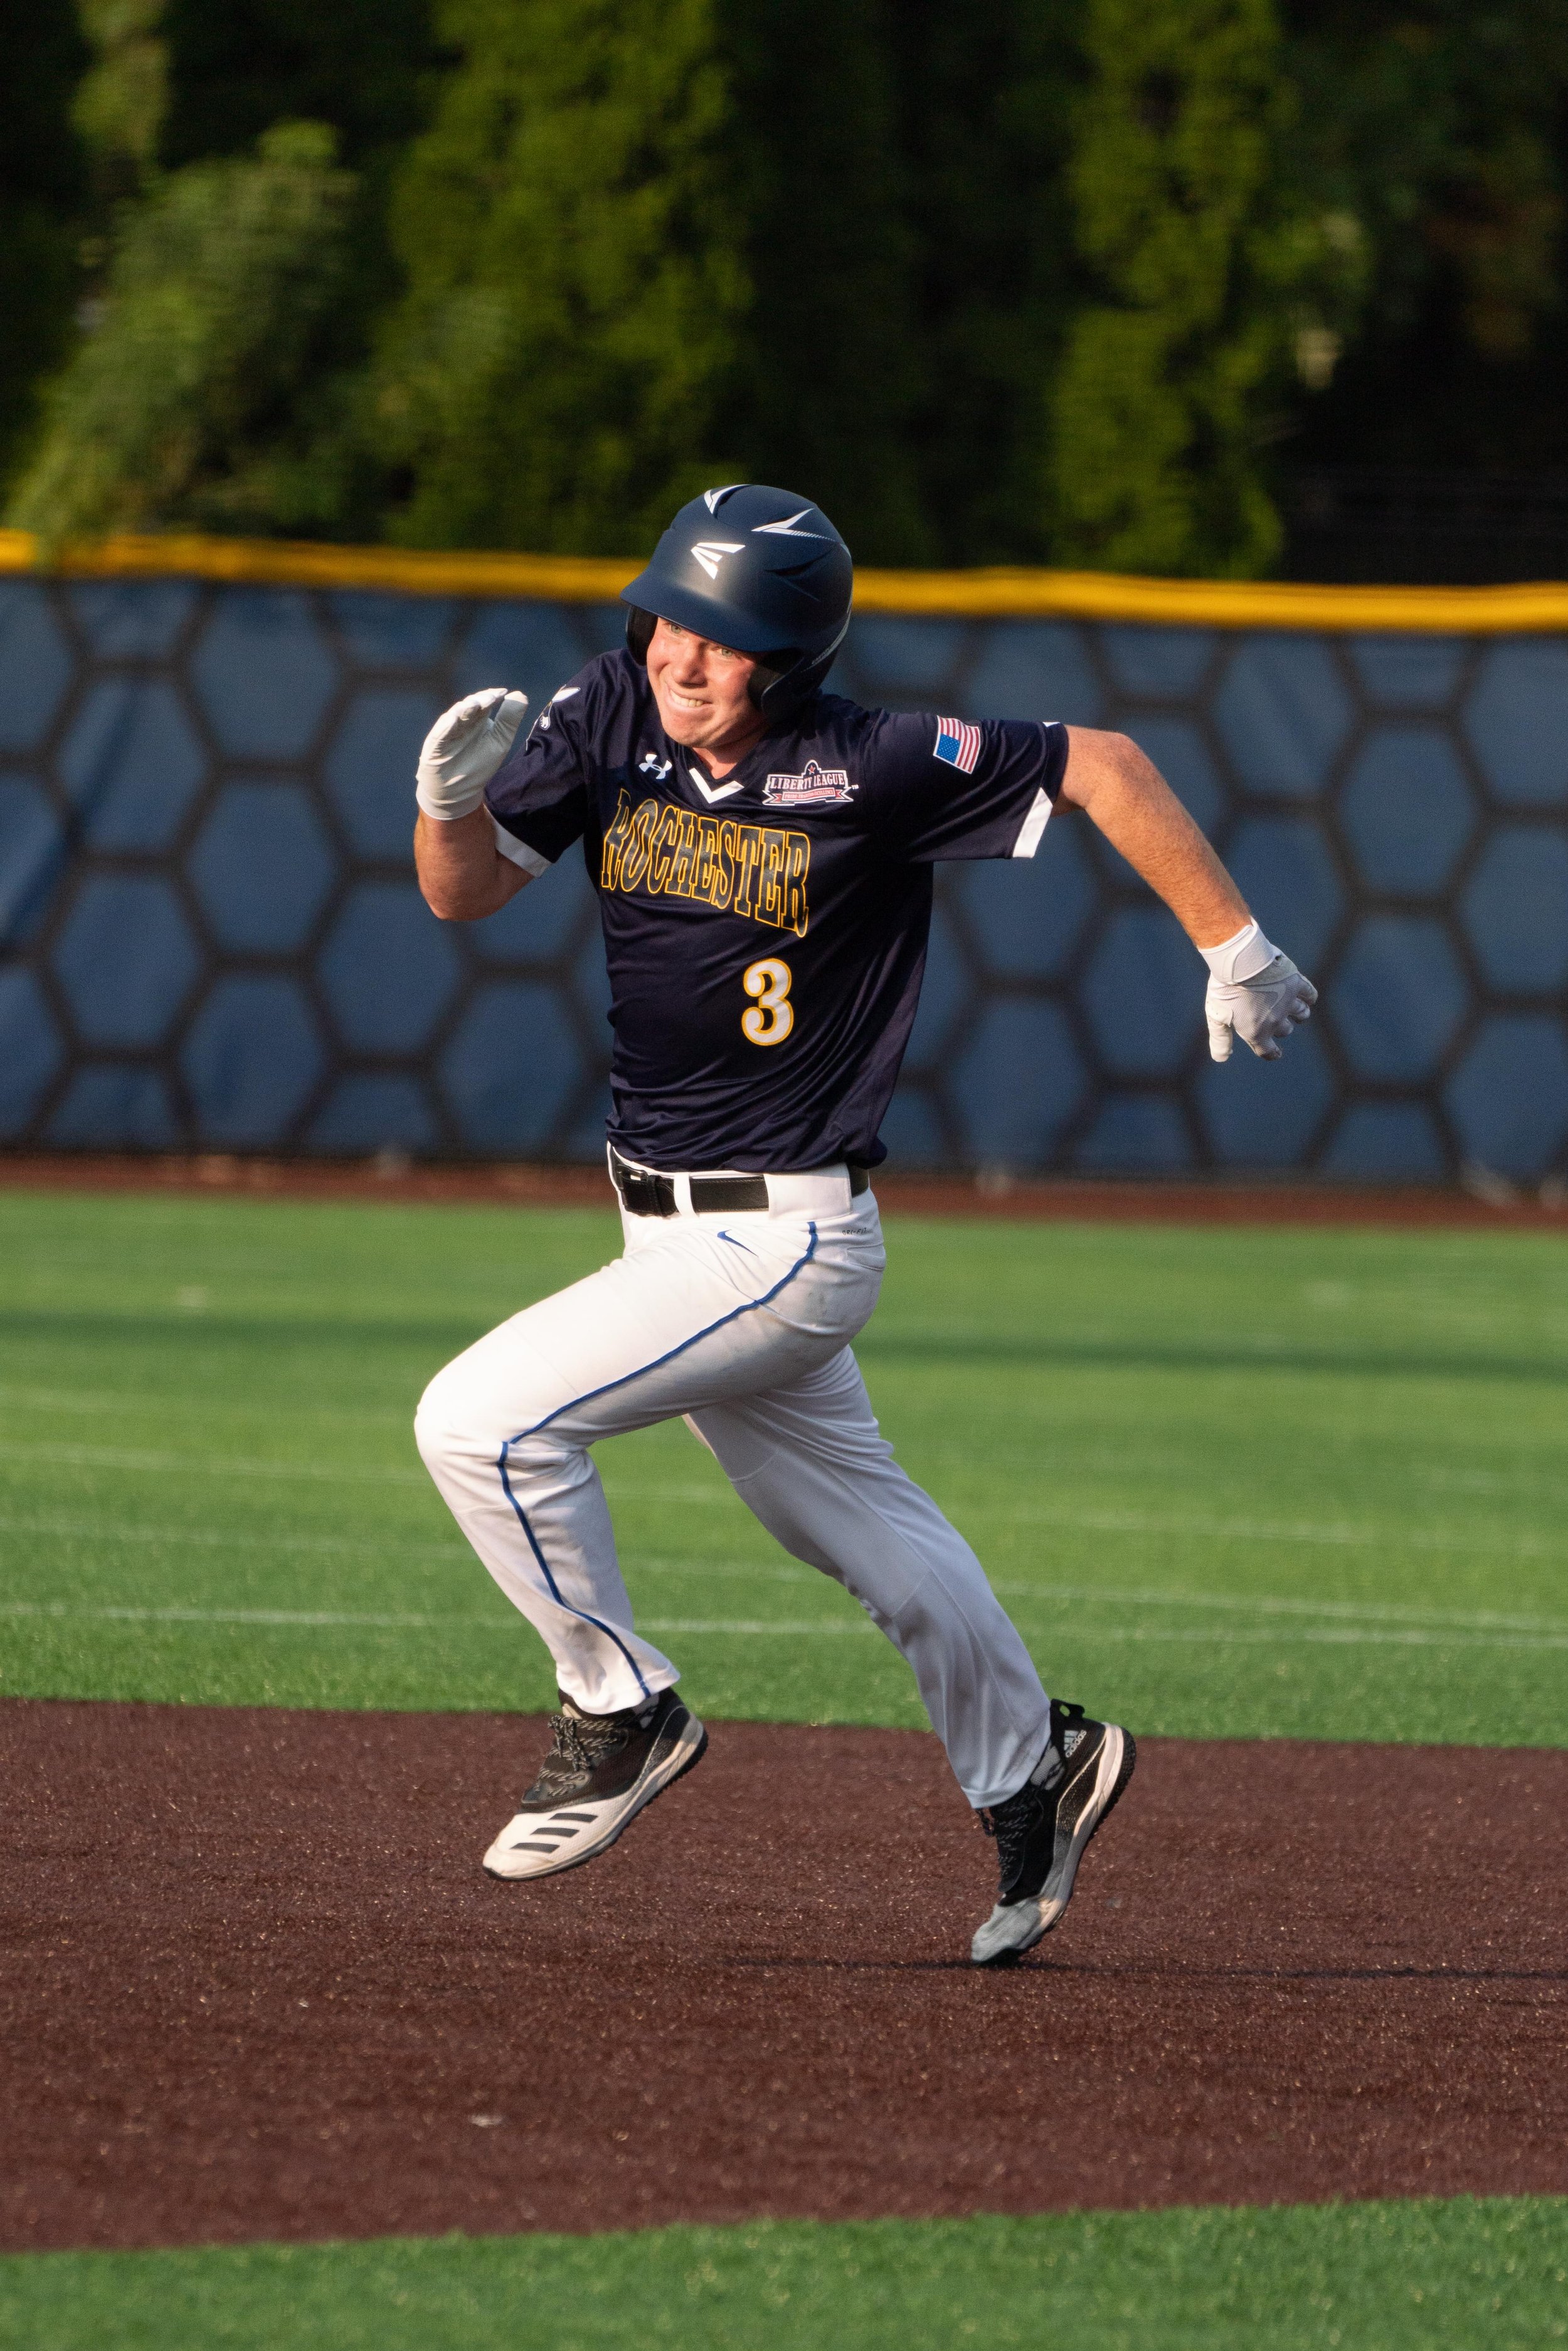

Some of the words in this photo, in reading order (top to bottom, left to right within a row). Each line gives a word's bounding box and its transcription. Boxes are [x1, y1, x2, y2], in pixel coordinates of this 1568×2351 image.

[770, 777, 812, 790] LIBERTY
[813, 774, 844, 787] LEAGUE
[601, 788, 811, 938] ROCHESTER
[741, 958, 794, 1046] 3
[1066, 1729, 1087, 1758] adidas
